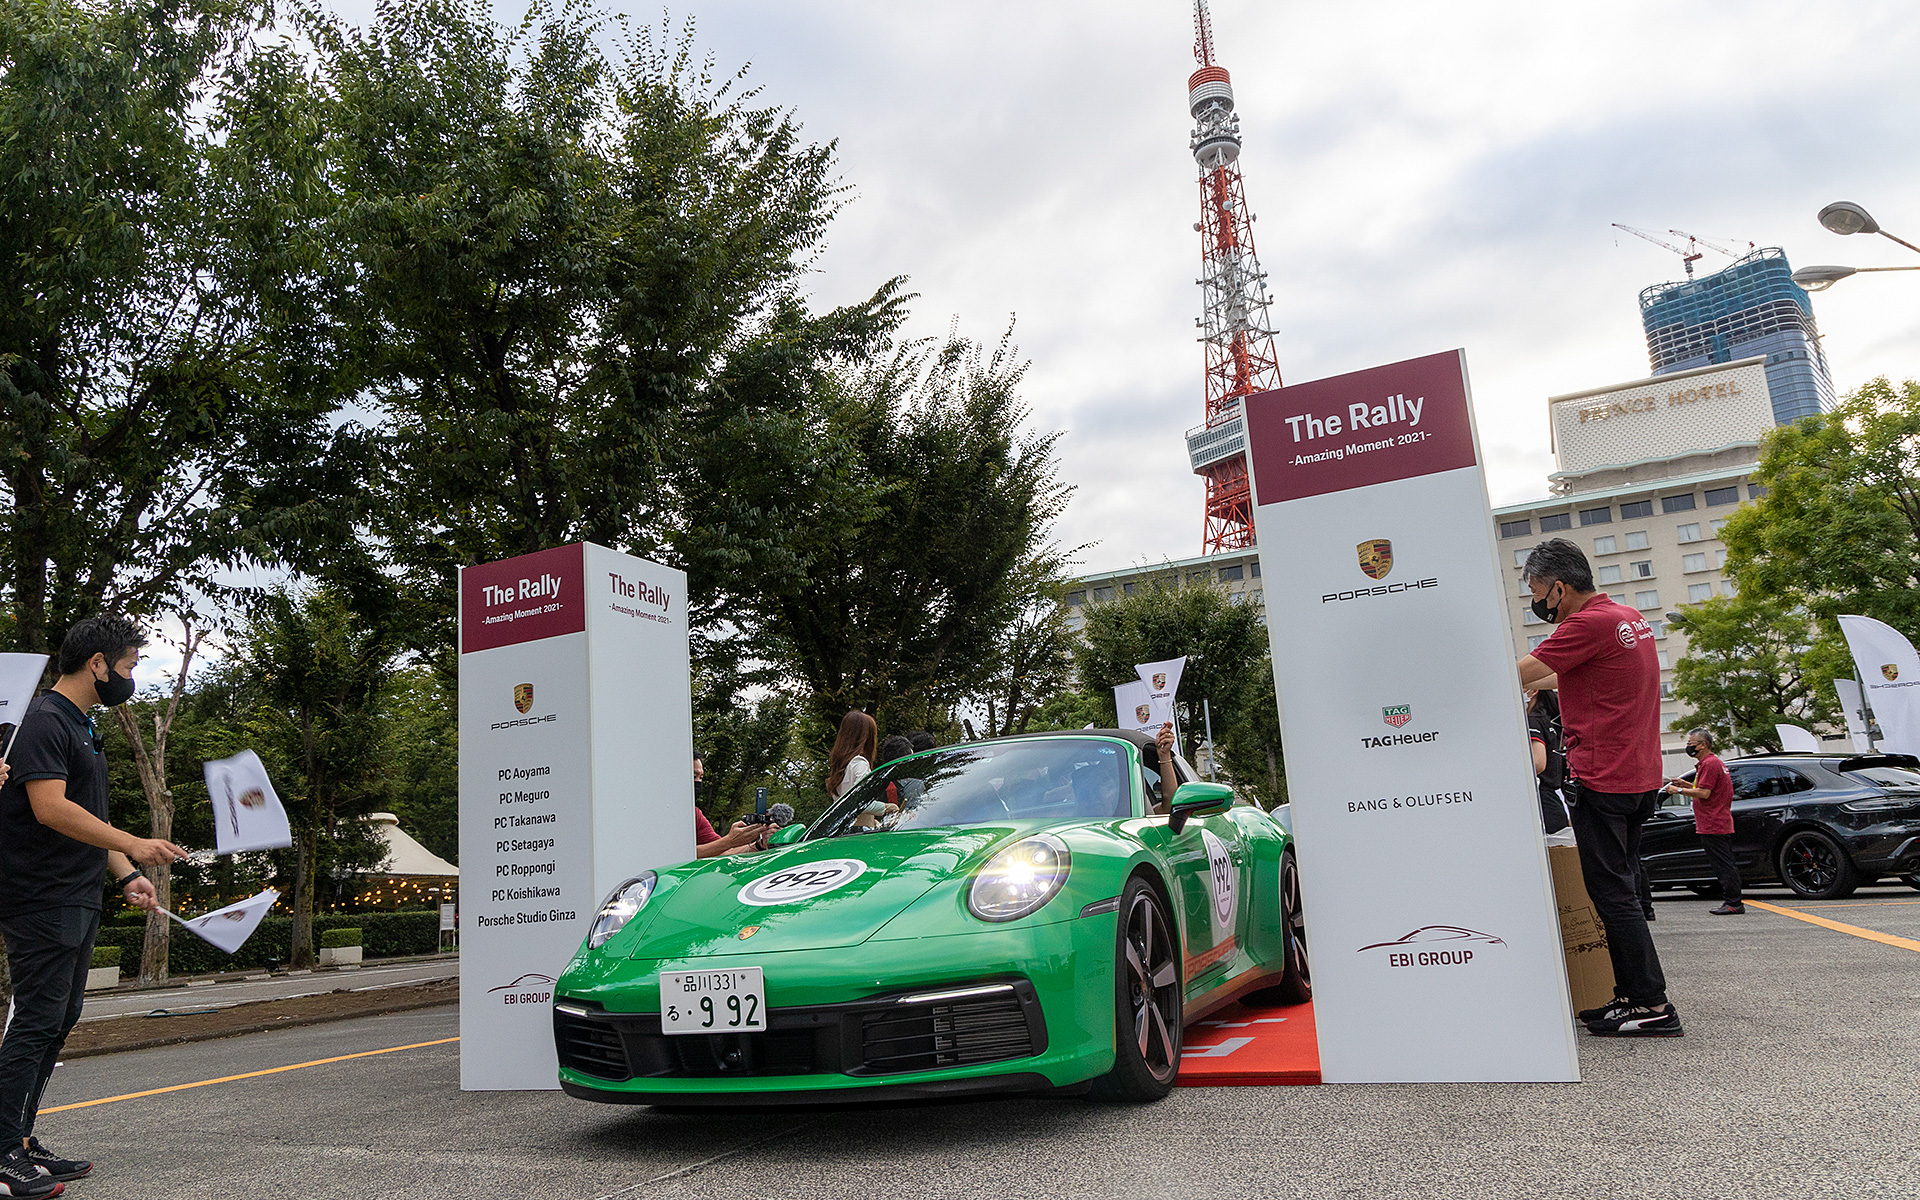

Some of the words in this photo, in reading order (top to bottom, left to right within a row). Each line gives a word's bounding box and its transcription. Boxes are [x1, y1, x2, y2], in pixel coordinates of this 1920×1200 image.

[1579, 396, 1656, 424] PRINCE
[1668, 380, 1741, 406] HOTEL
[1285, 413, 1342, 443] The
[1348, 393, 1424, 431] Rally
[1288, 448, 1344, 466] -Amazing
[1345, 436, 1395, 456] Moment
[1397, 430, 1432, 446] 2021-
[482, 584, 515, 607] The
[518, 574, 562, 600] Rally
[608, 572, 636, 599] The
[638, 581, 671, 612] Rally
[1322, 577, 1438, 604] PORSCHE
[481, 613, 514, 625] -Amazing
[514, 607, 543, 620] Moment
[543, 603, 564, 613] 2021-
[608, 602, 636, 618] -Amazing
[635, 609, 657, 622] Moment
[657, 614, 672, 625] 2021-
[1385, 707, 1408, 715] TAG
[1386, 714, 1410, 726] HEUER
[490, 713, 557, 731] PORSCHE
[498, 768, 512, 781] PC
[513, 765, 550, 781] Aoyama
[499, 792, 513, 805] PC
[514, 790, 550, 804] Meguro
[1348, 799, 1388, 813] BANG
[1393, 797, 1402, 809] &
[1405, 791, 1474, 808] OLUFSEN
[494, 817, 508, 829] PC
[508, 813, 556, 828] Takanawa
[496, 841, 510, 853] PC
[511, 837, 555, 852] Setagaya
[496, 865, 510, 877] PC
[511, 860, 556, 877] Roppongi
[1214, 856, 1230, 894] 992
[763, 869, 843, 890] 992
[492, 889, 505, 902] PC
[506, 886, 561, 901] Koishikawa
[478, 914, 515, 928] Porsche
[516, 911, 548, 925] Studio
[549, 909, 576, 923] Ginza
[1389, 953, 1415, 967] EBI
[1417, 950, 1474, 966] GROUP
[504, 993, 518, 1005] EBI
[519, 992, 551, 1004] GROUP
